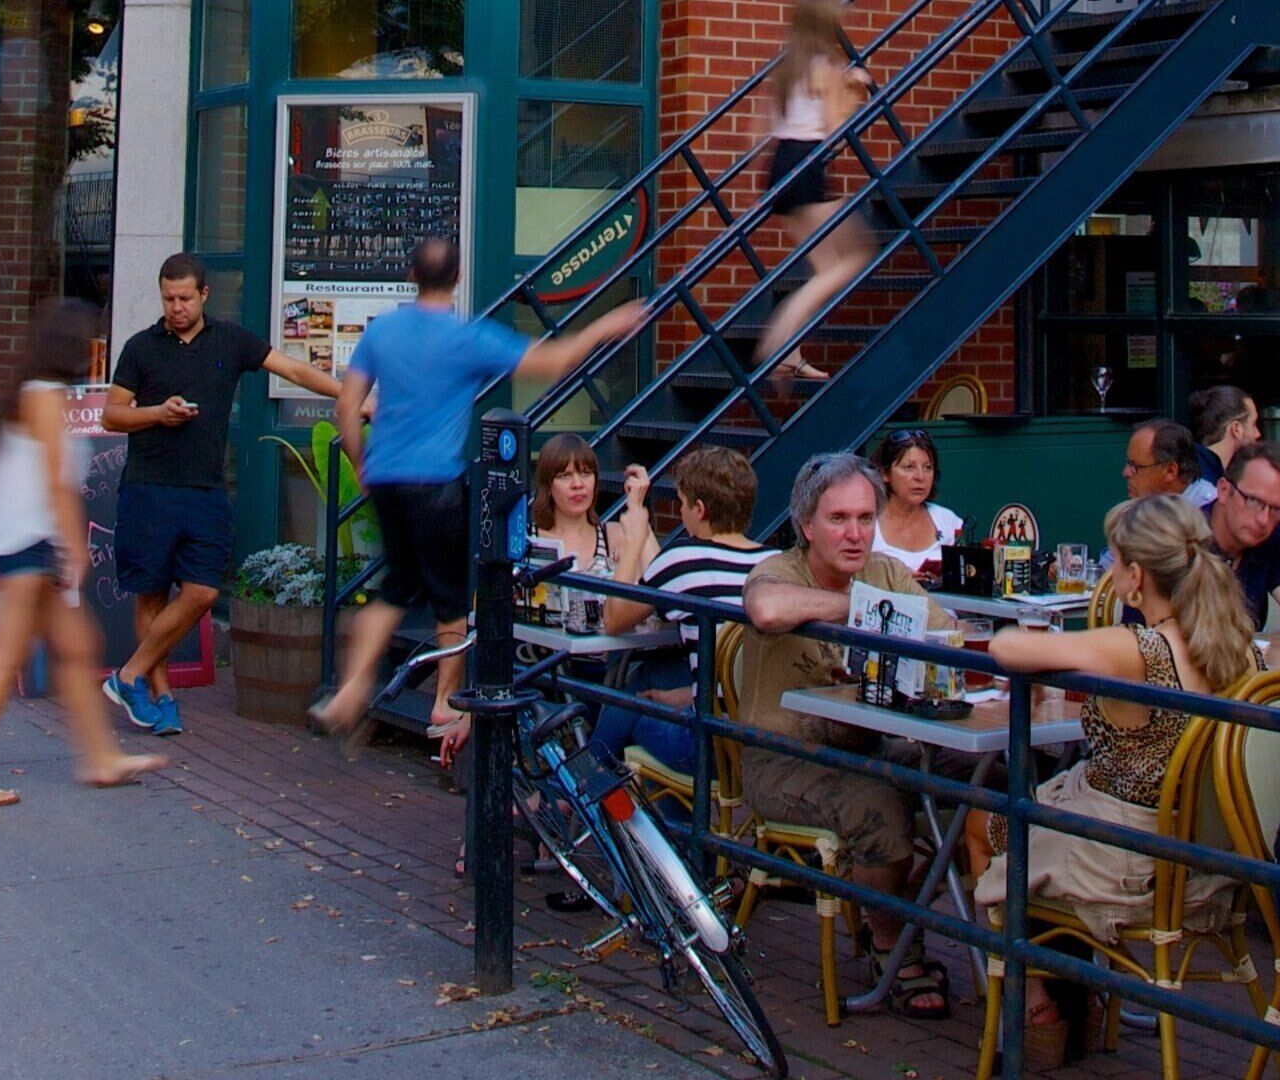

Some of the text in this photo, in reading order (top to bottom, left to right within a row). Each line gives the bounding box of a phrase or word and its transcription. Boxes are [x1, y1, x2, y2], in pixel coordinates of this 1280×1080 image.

[346, 124, 408, 140] BRASSEURS
[551, 220, 628, 286] Terrasse
[306, 283, 384, 293] Restaurant
